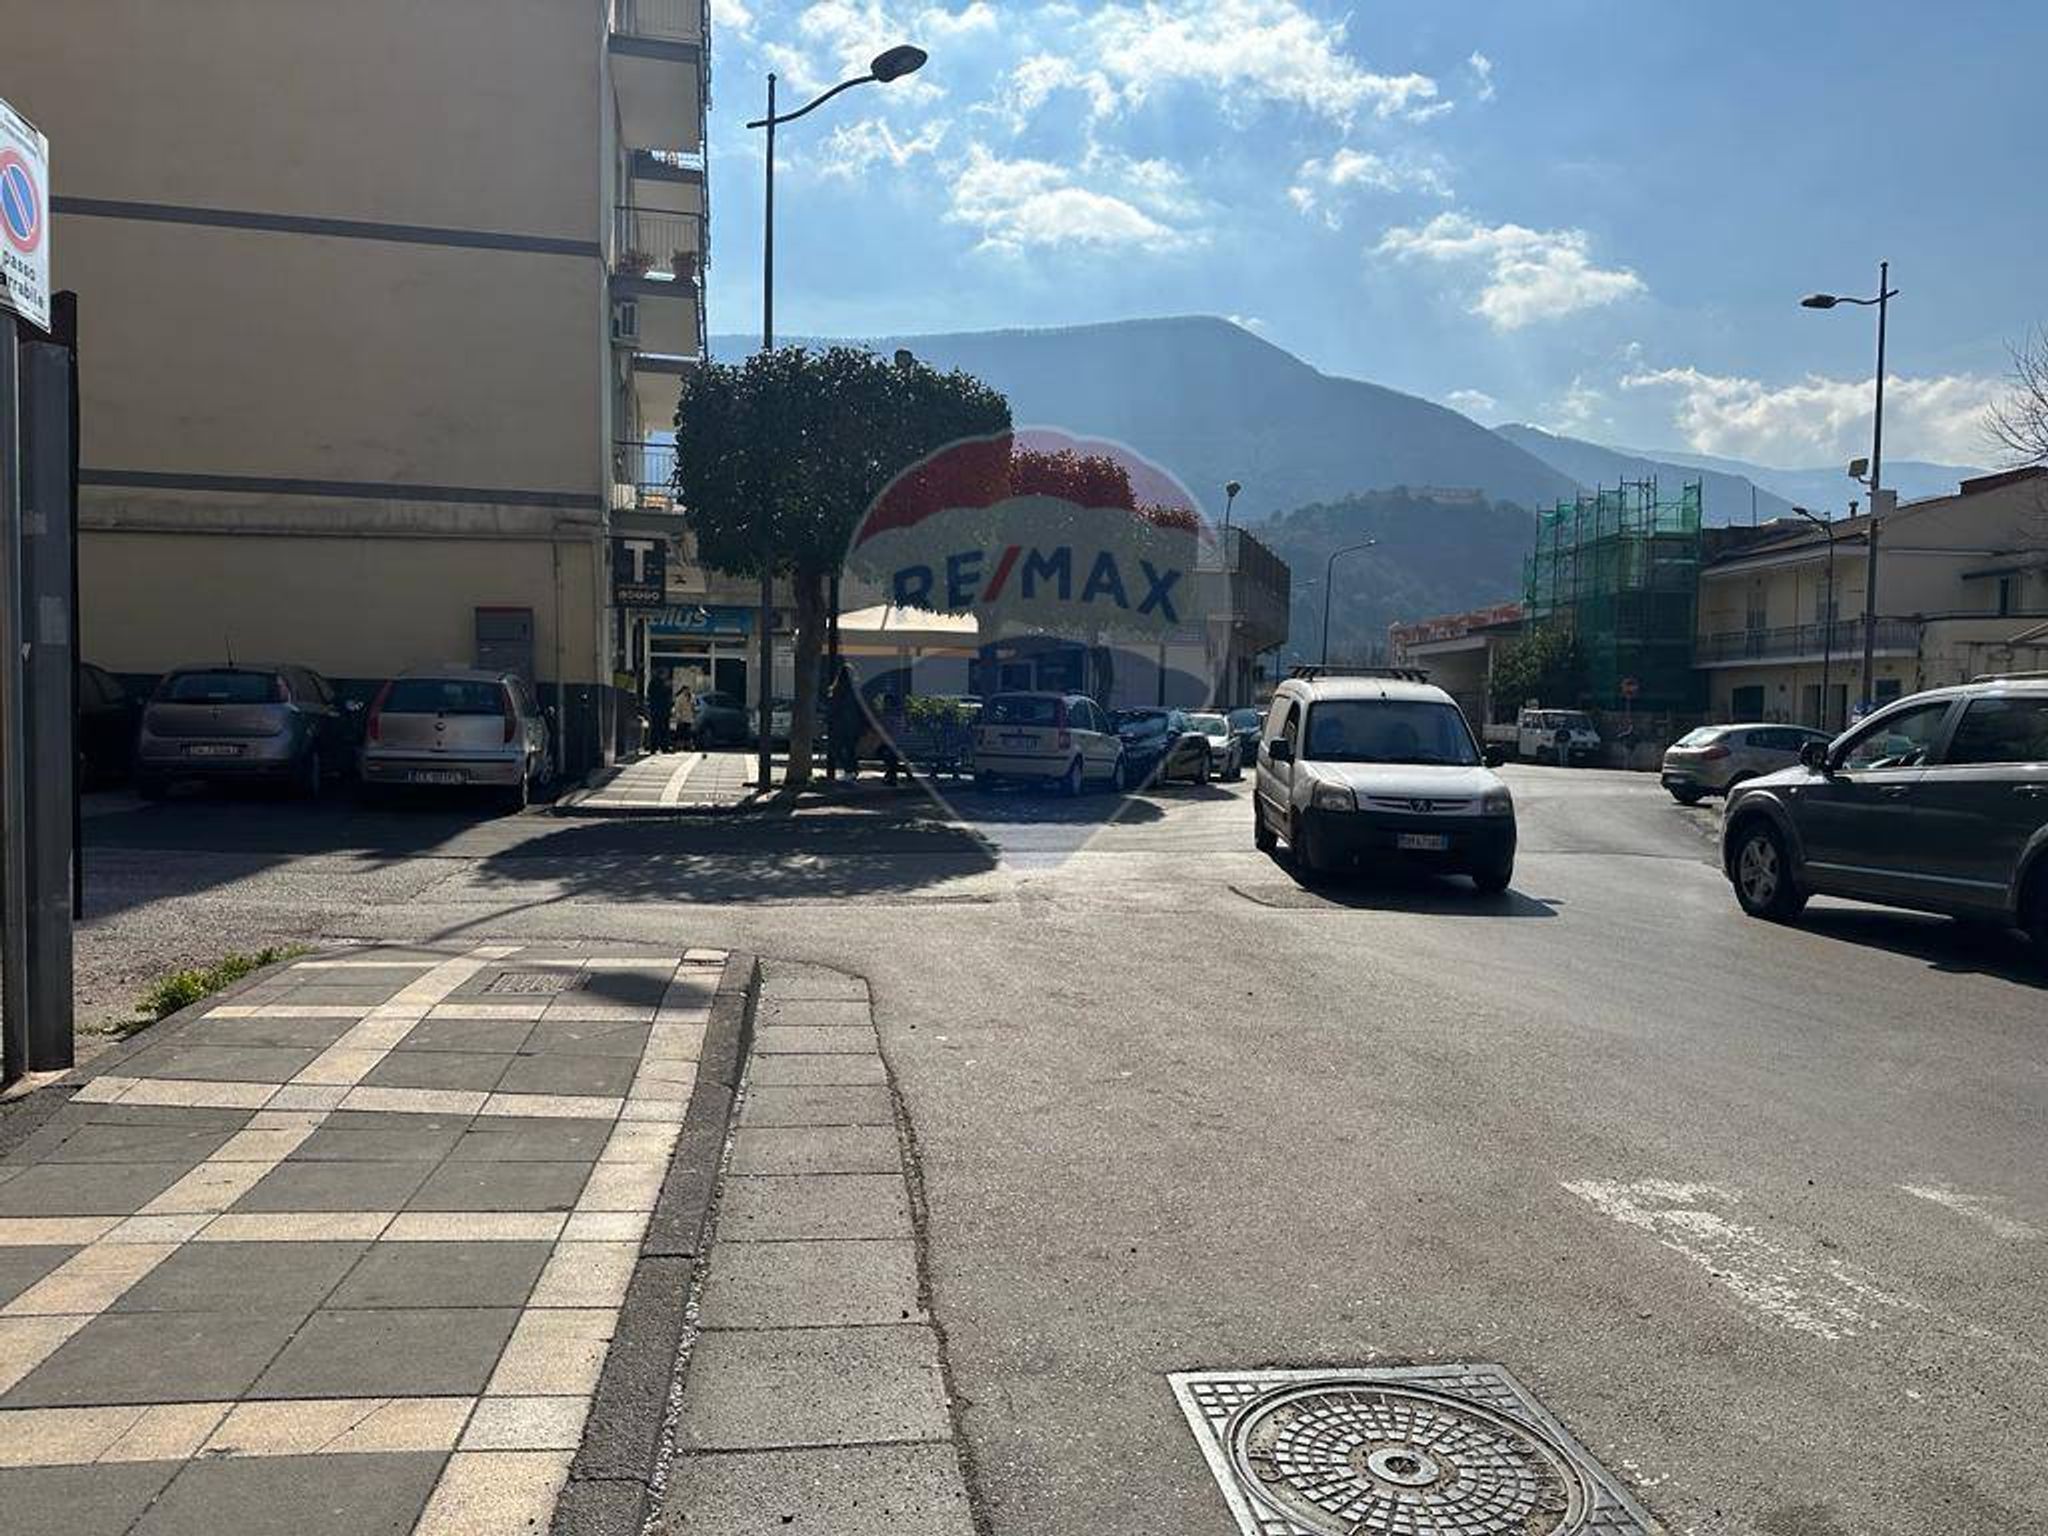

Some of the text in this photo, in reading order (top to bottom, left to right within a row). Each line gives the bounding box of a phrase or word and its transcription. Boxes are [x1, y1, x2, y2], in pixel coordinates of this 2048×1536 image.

[4, 250, 35, 281] passo
[0, 271, 43, 309] arrabile
[624, 540, 654, 582] T
